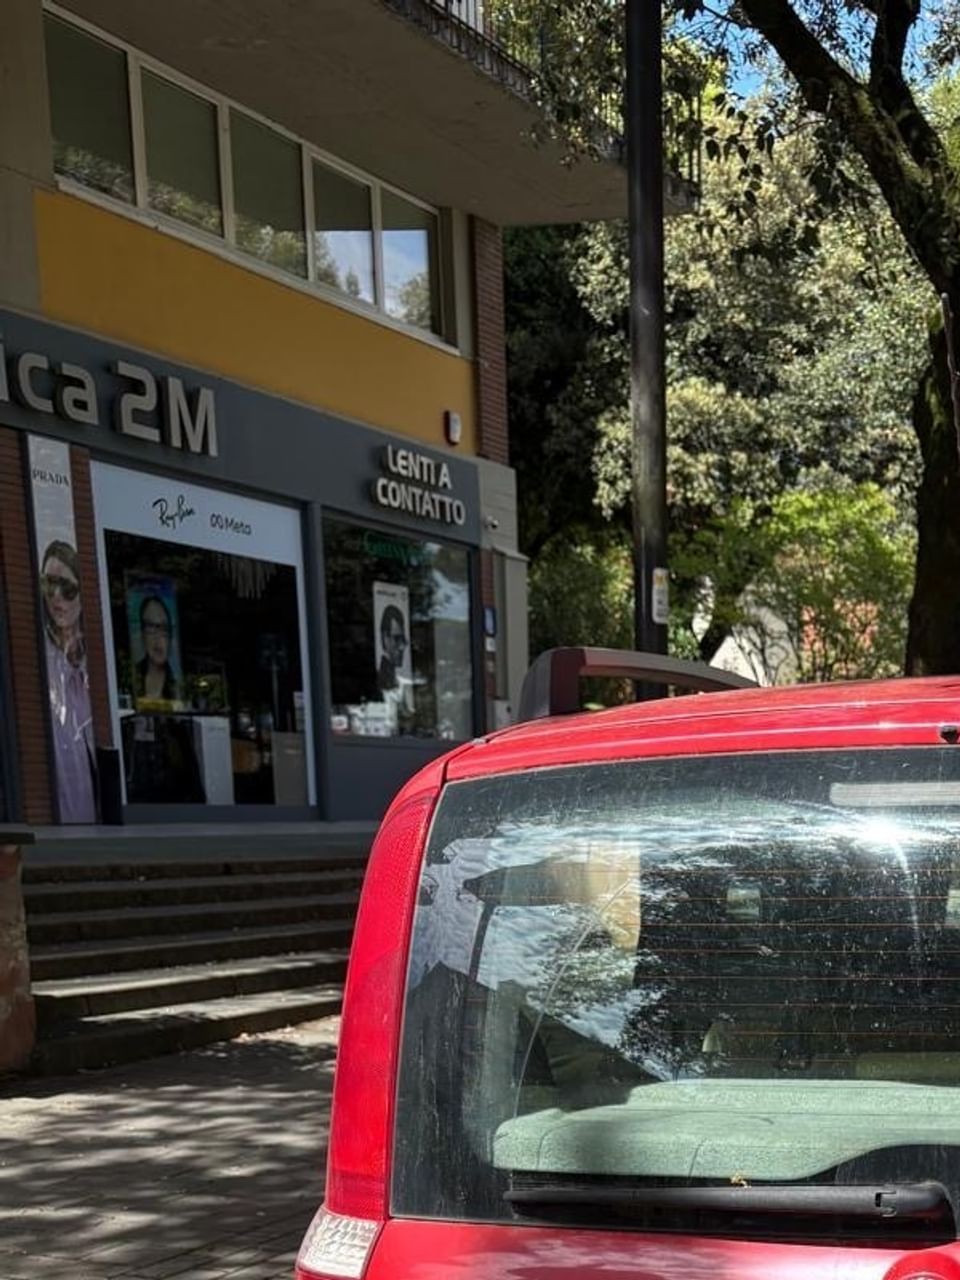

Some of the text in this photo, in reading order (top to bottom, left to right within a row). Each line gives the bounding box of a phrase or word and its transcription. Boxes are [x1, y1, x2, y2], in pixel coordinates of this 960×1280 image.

[116, 360, 218, 458] 2M
[32, 468, 70, 487] PRADA
[388, 444, 452, 490] LENTI A
[377, 478, 466, 525] CONTATTO
